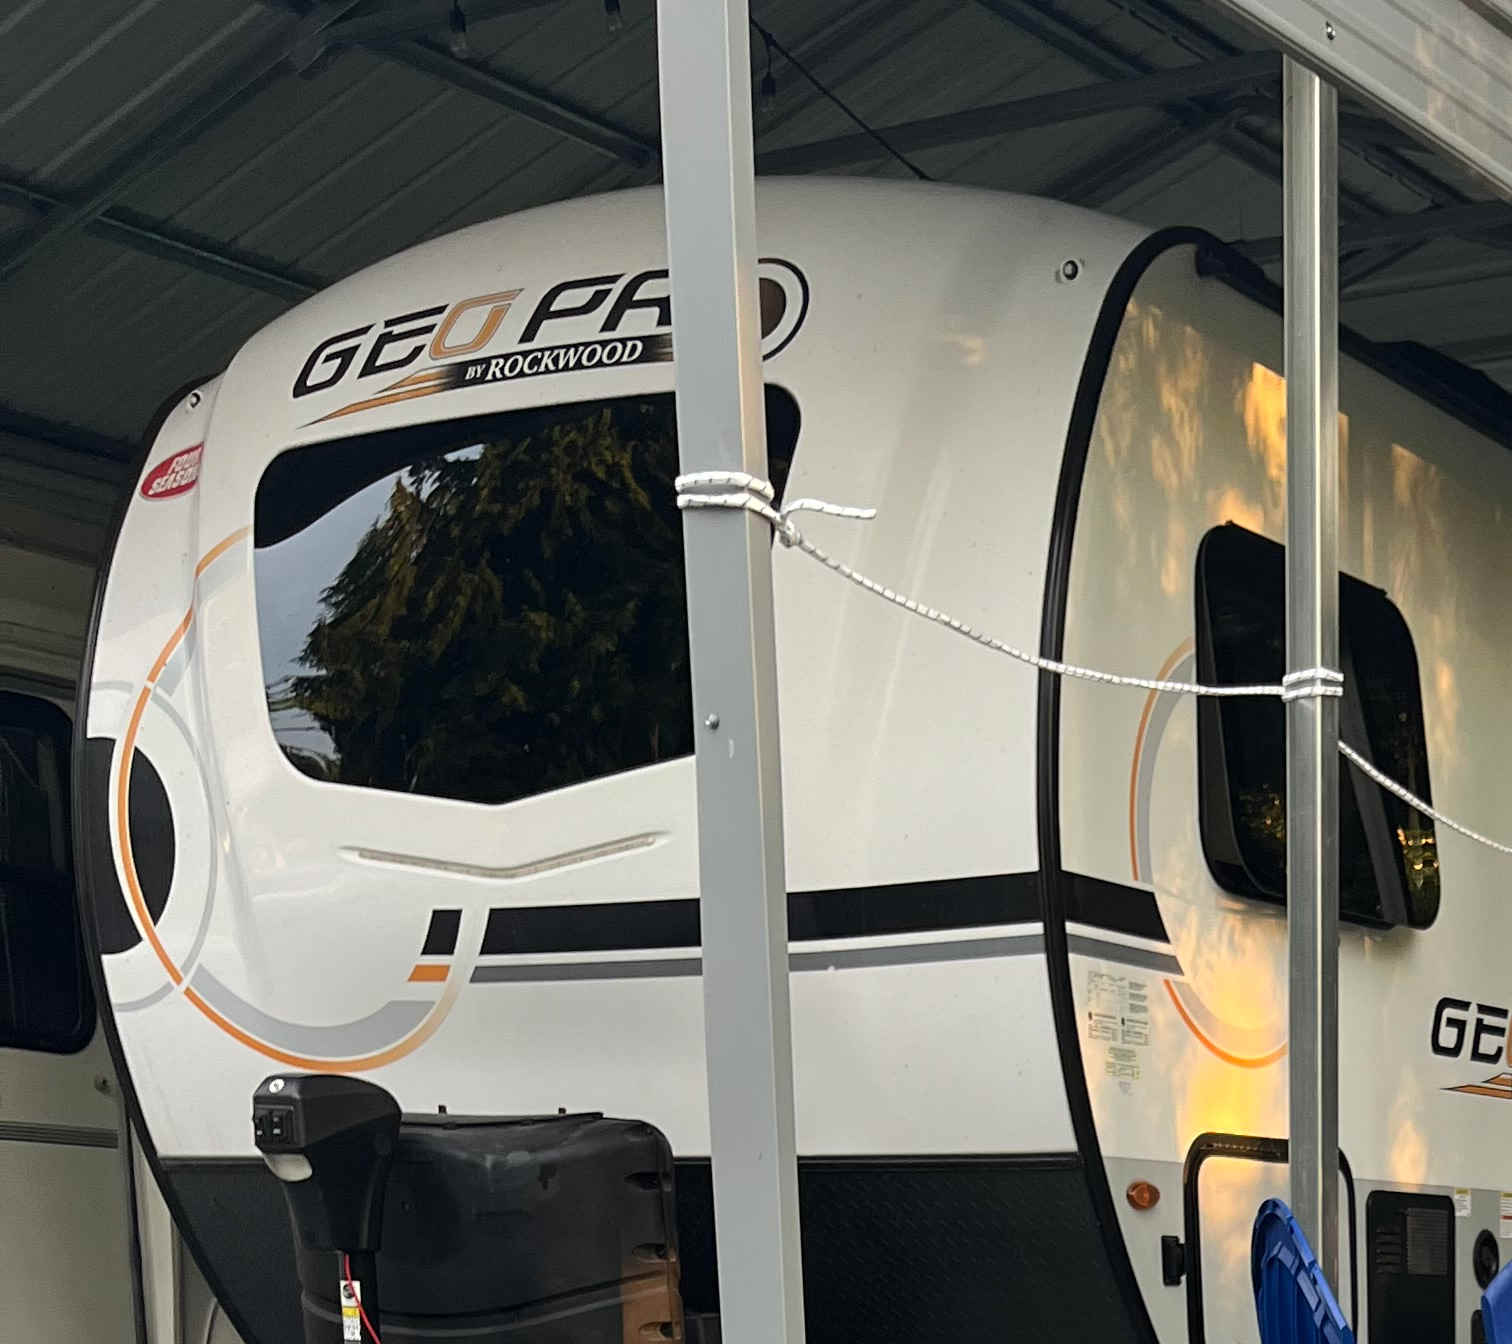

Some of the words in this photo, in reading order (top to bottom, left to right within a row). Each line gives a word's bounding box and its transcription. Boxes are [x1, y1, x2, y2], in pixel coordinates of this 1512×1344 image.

[292, 288, 524, 398] GEO
[464, 364, 486, 382] BY
[485, 339, 644, 381] ROCKWOOD
